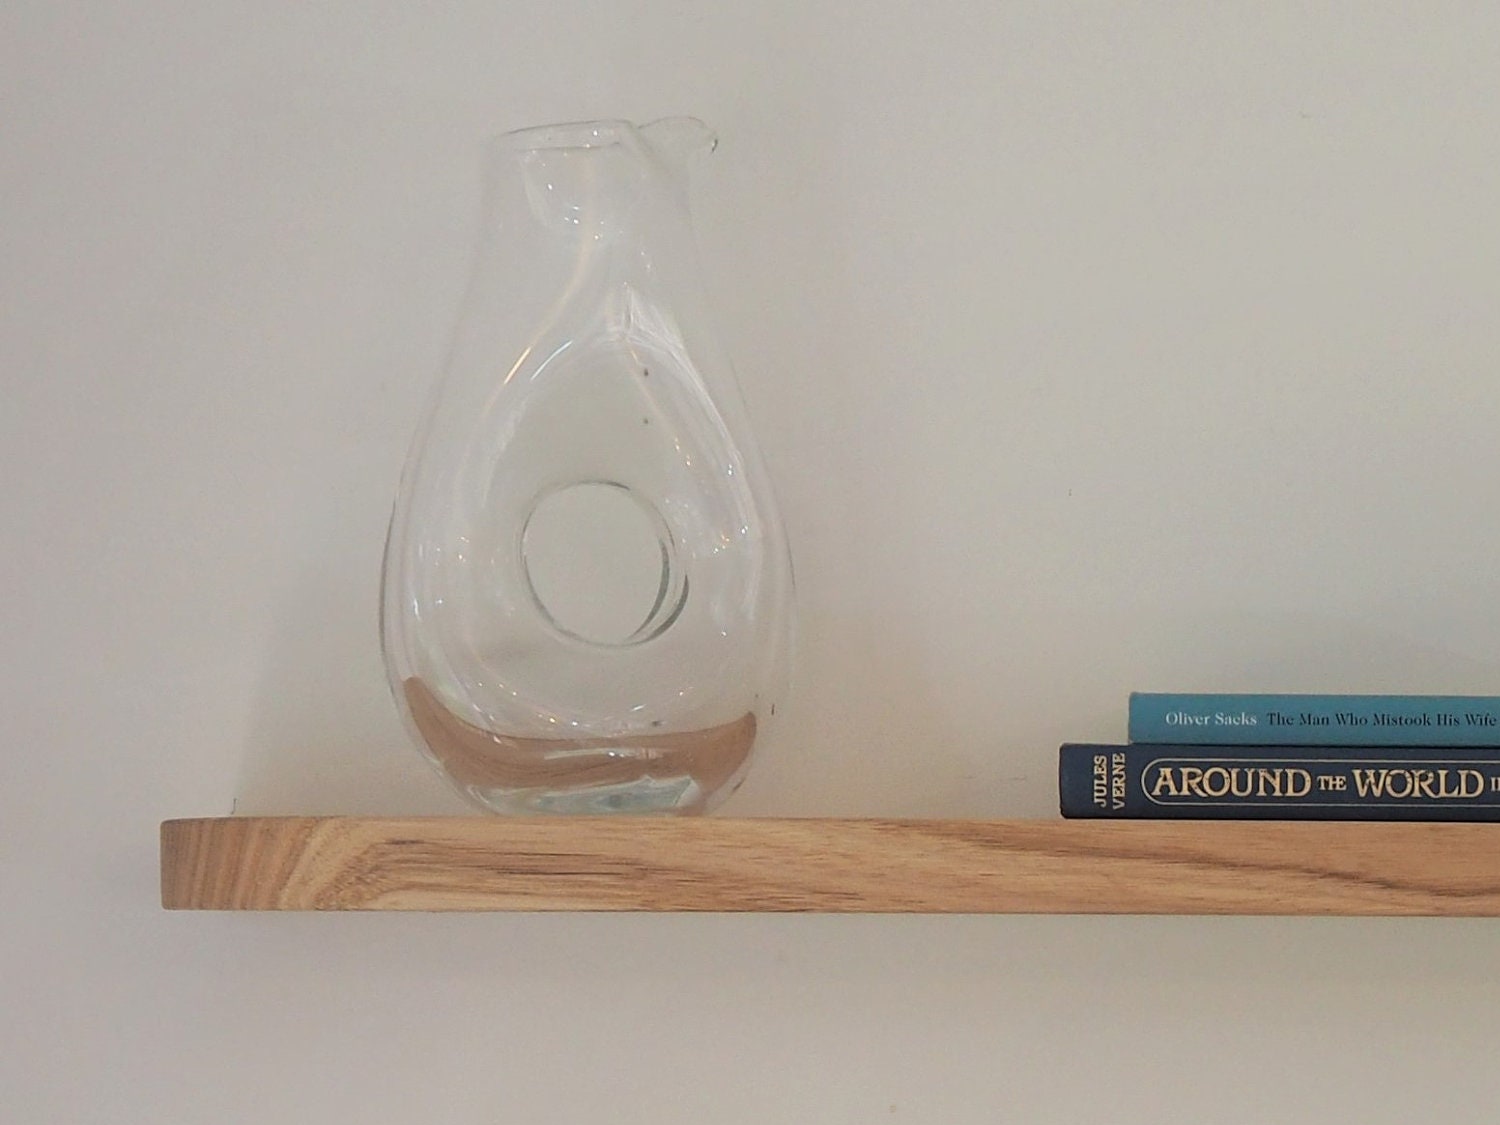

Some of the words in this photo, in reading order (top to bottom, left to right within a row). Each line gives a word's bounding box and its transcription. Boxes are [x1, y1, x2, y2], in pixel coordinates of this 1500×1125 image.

[1165, 711, 1210, 726] Oliver
[1214, 711, 1258, 726] Sacks
[1267, 712, 1294, 726] The
[1299, 712, 1330, 726] Man
[1335, 712, 1369, 726] Who
[1373, 712, 1431, 727] Mistook
[1436, 713, 1460, 727] His
[1464, 713, 1497, 727] Wife
[1093, 754, 1108, 808] JULES
[1112, 752, 1126, 810] VERNE
[1150, 766, 1312, 798] AROUND
[1316, 775, 1347, 791] THE
[1352, 768, 1485, 799] WORLD
